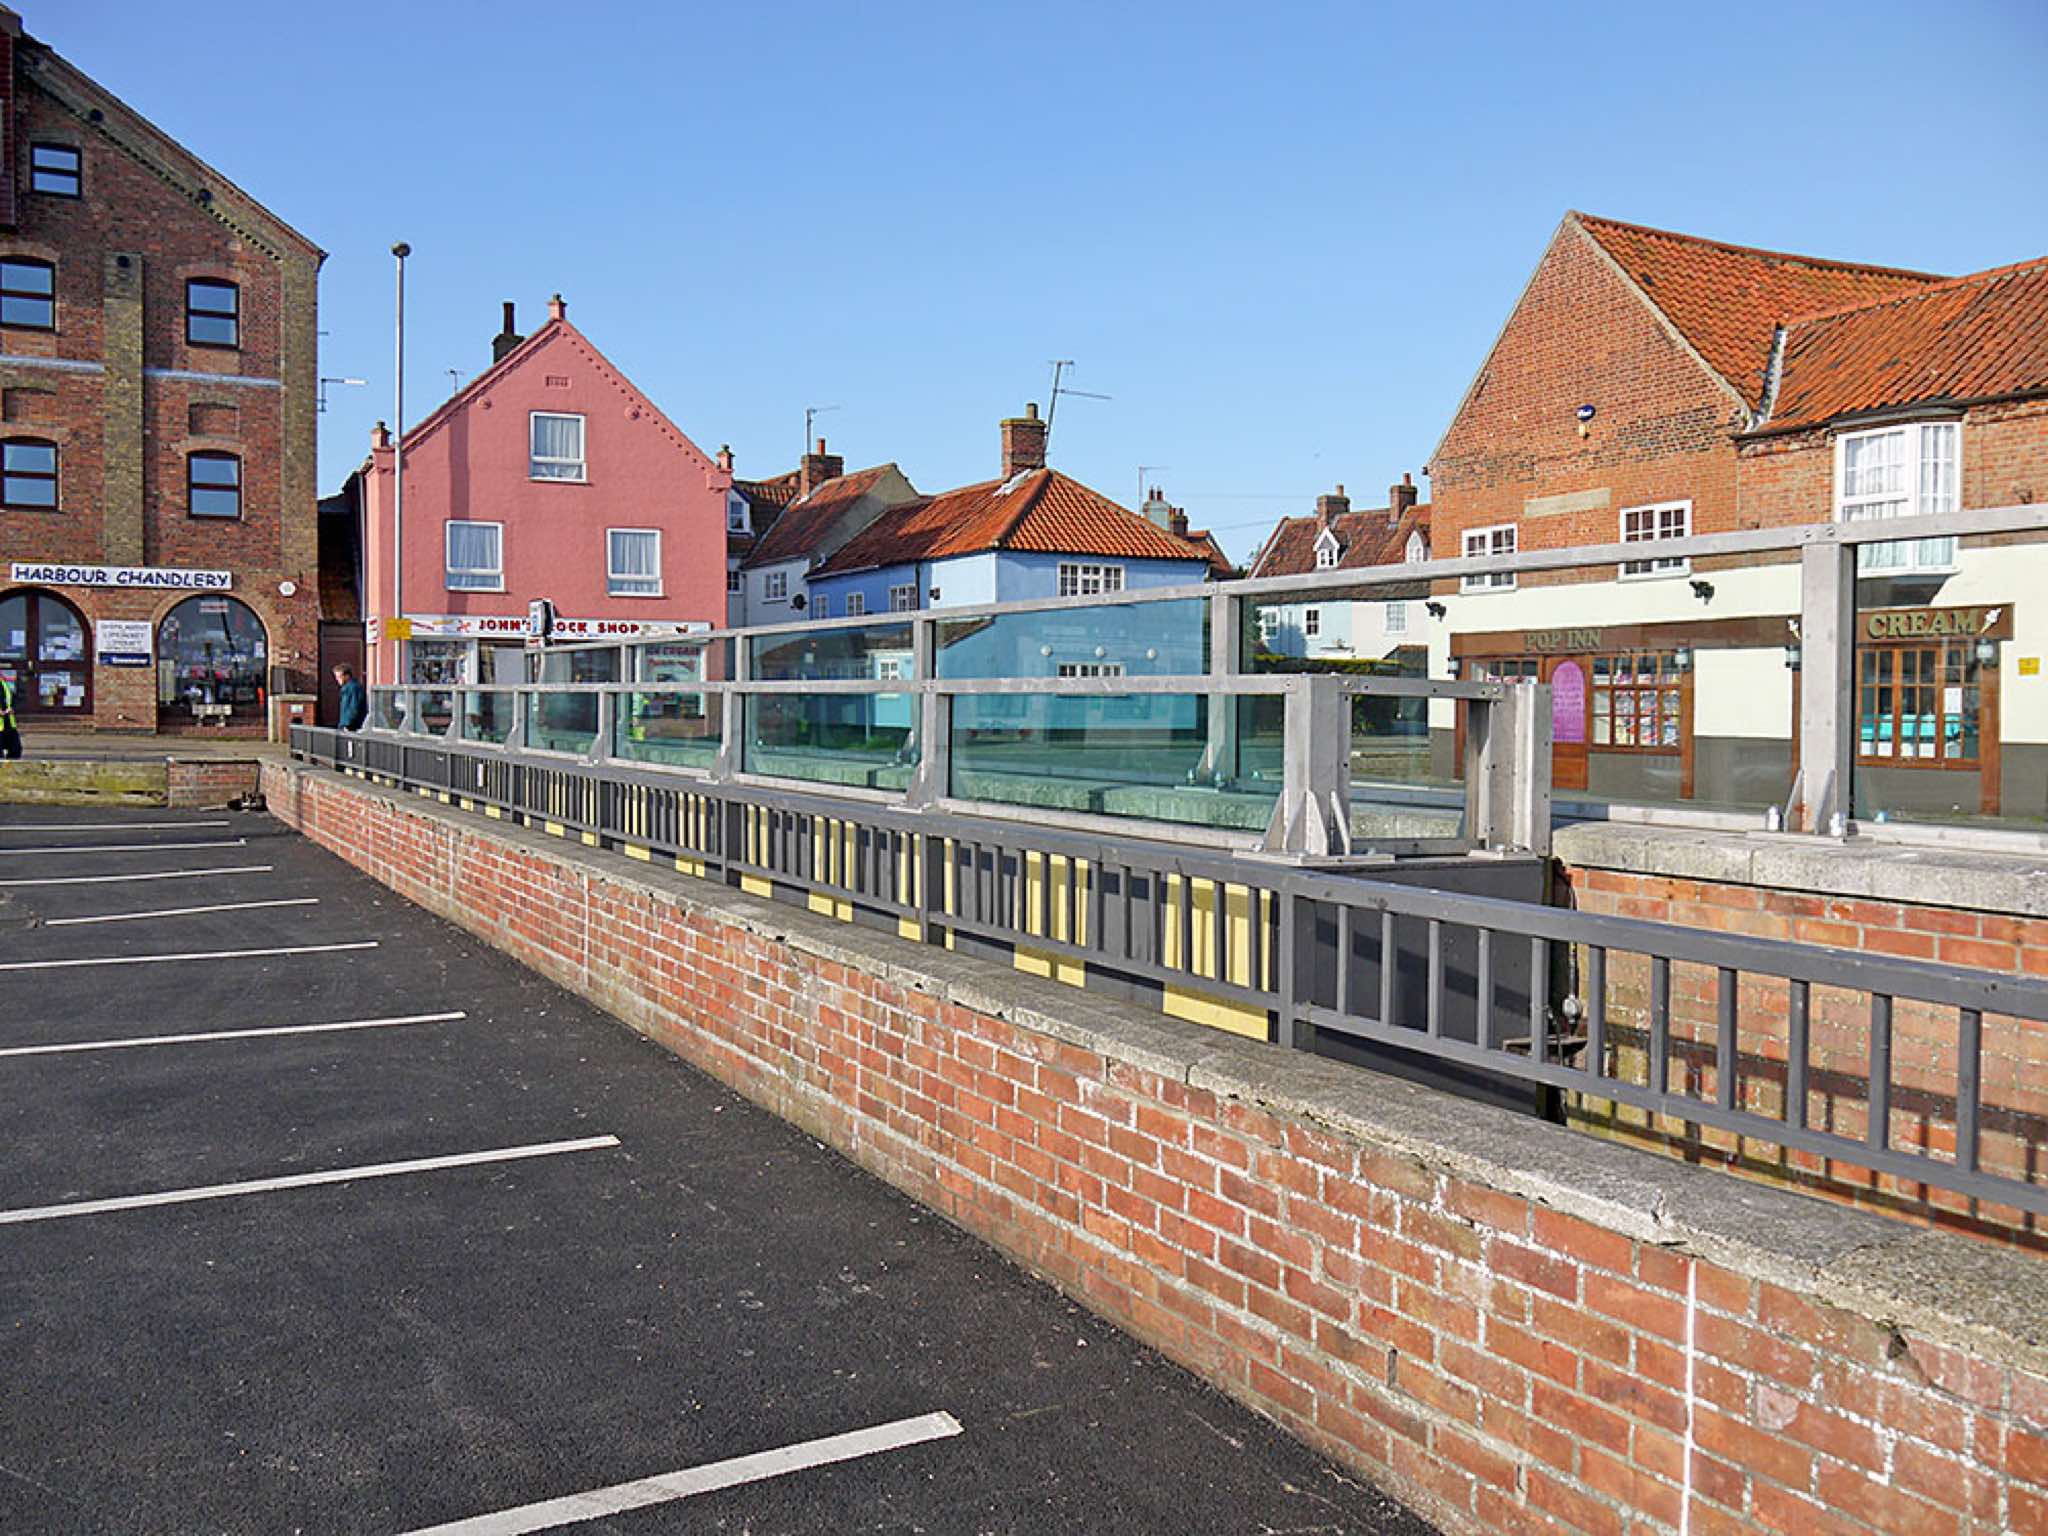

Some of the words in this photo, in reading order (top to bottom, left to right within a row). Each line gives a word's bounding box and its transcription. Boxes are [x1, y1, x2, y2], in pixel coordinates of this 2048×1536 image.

[16, 566, 107, 582] HARBOUR
[117, 571, 228, 587] CHANDLERY
[553, 621, 587, 633] OCK
[598, 622, 640, 633] SHOP
[1869, 609, 1979, 638] CREAM
[1525, 631, 1561, 651] POP
[1568, 629, 1601, 649] INN
